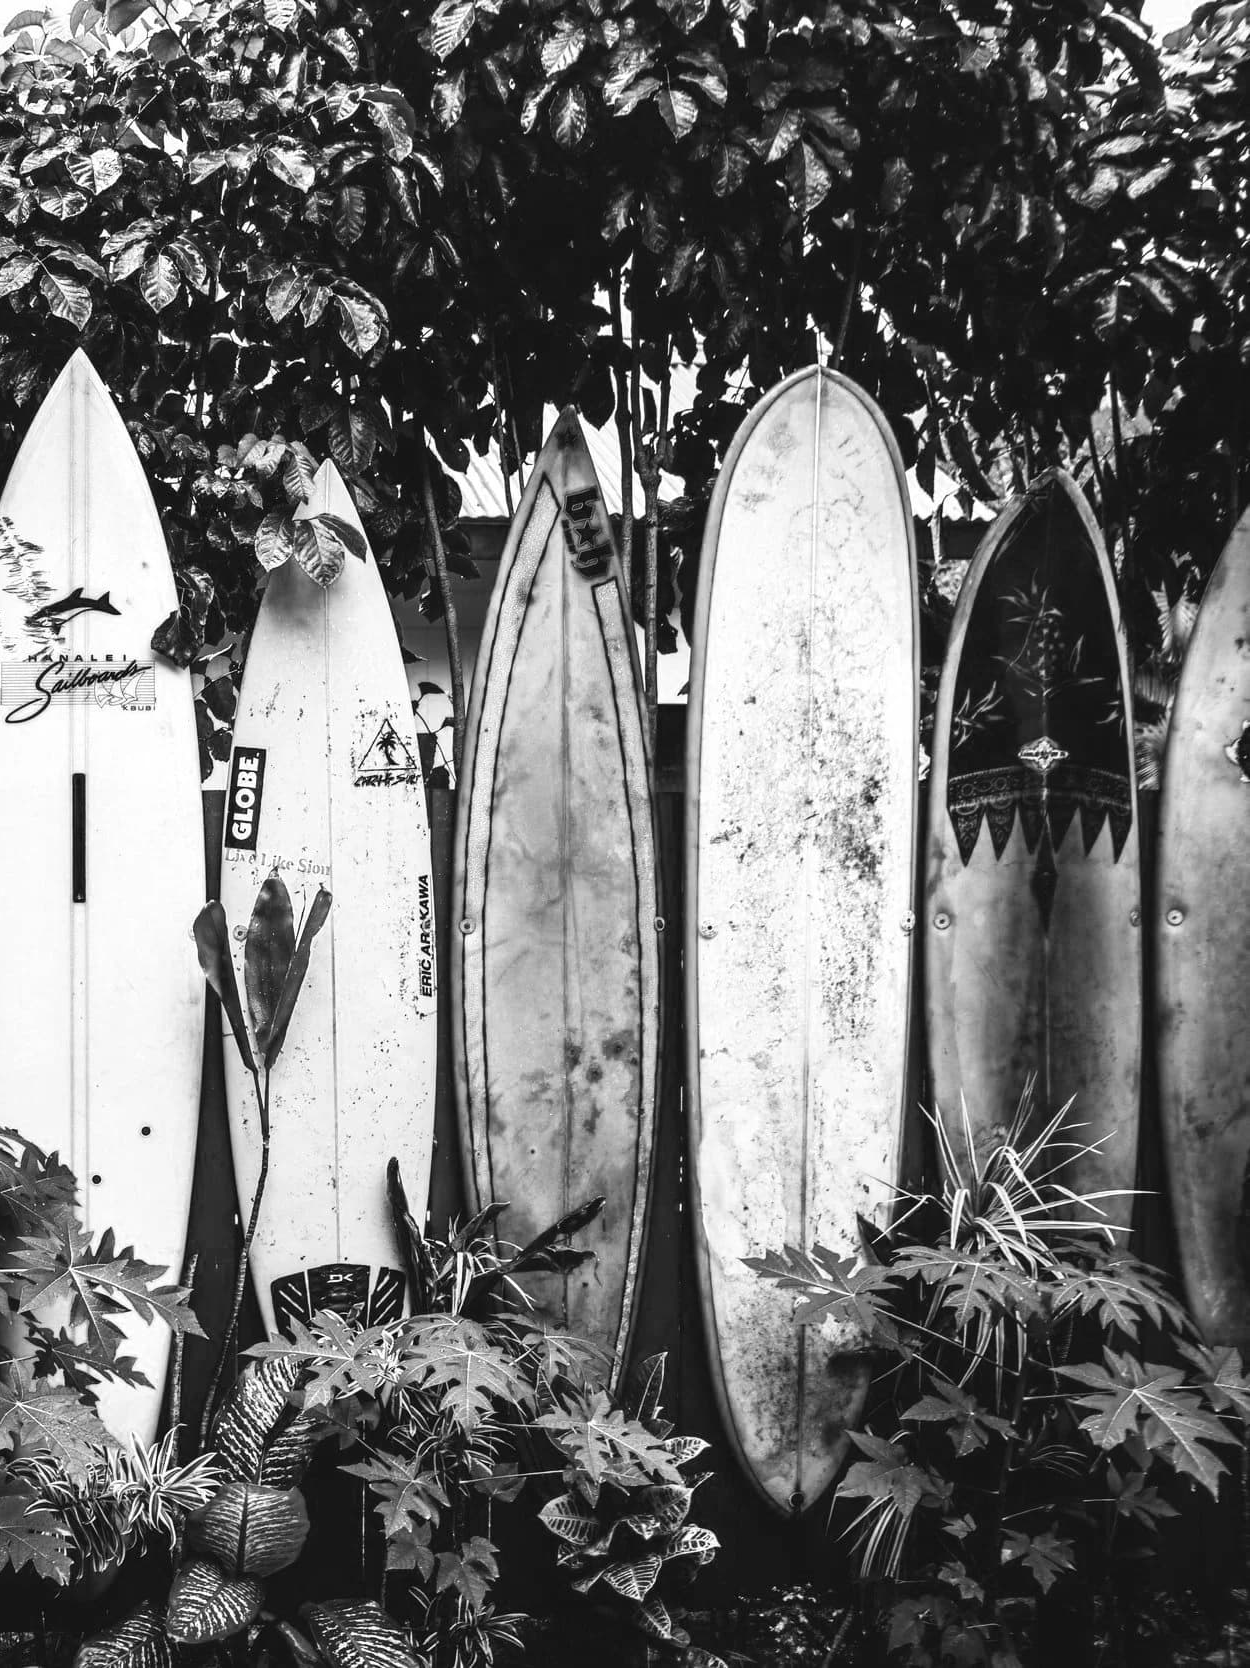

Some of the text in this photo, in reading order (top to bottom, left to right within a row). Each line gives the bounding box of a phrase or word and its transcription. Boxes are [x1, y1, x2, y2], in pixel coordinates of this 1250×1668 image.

[28, 654, 127, 662] HANALEI
[5, 660, 152, 723] Sailboards
[261, 853, 294, 870] Like
[418, 874, 432, 997] ERIC ARKAWA
